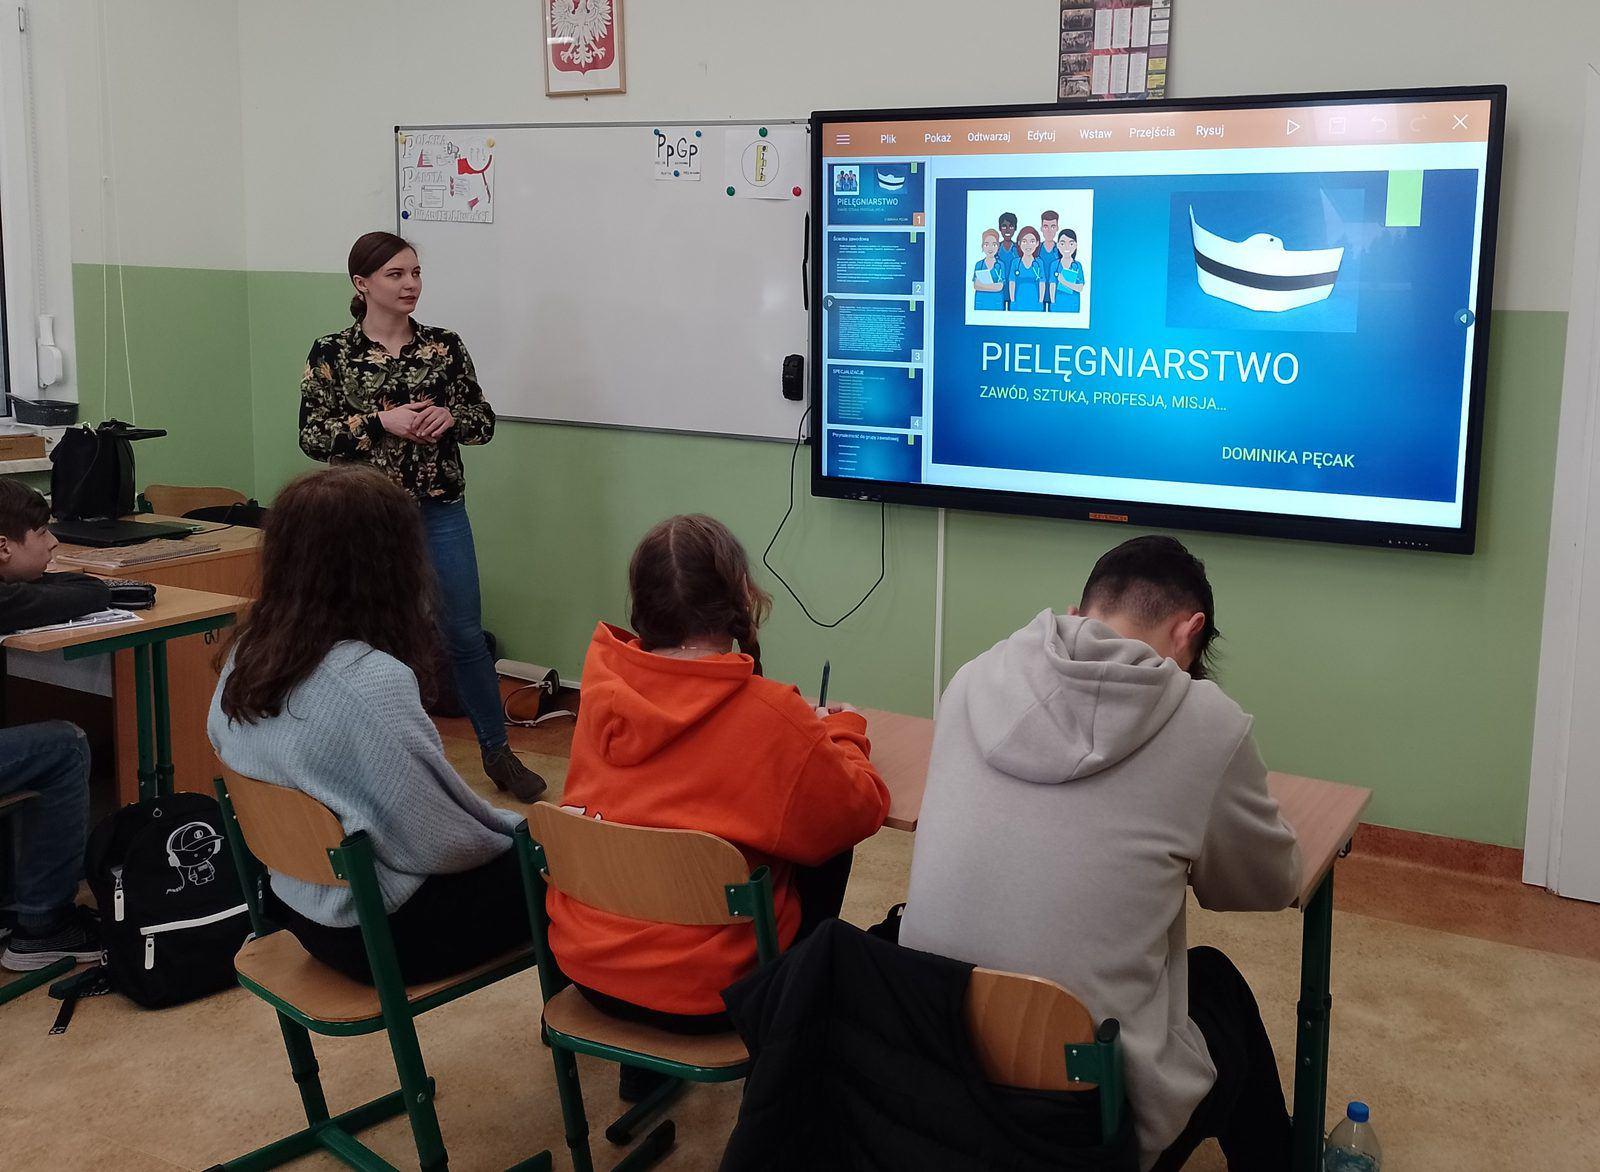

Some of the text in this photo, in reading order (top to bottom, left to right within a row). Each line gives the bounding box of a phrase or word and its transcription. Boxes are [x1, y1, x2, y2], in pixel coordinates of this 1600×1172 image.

[924, 131, 952, 144] Pokaż
[967, 130, 1011, 143] Odtwarzaj
[1027, 130, 1056, 142] Edytuj
[1079, 128, 1112, 140] Wstaw
[1128, 126, 1176, 140] Przejścia
[1196, 124, 1224, 138] Rysuj
[880, 134, 897, 144] Plik
[837, 197, 898, 207] PIELĘGNIARSTWO
[980, 342, 1300, 385] PIELĘGNIARSTWO
[979, 385, 1227, 412] ZAWÓD, SZTUKA, PROFESJA, MISJA...
[1222, 446, 1356, 470] DOMINIKA PĘCAK
